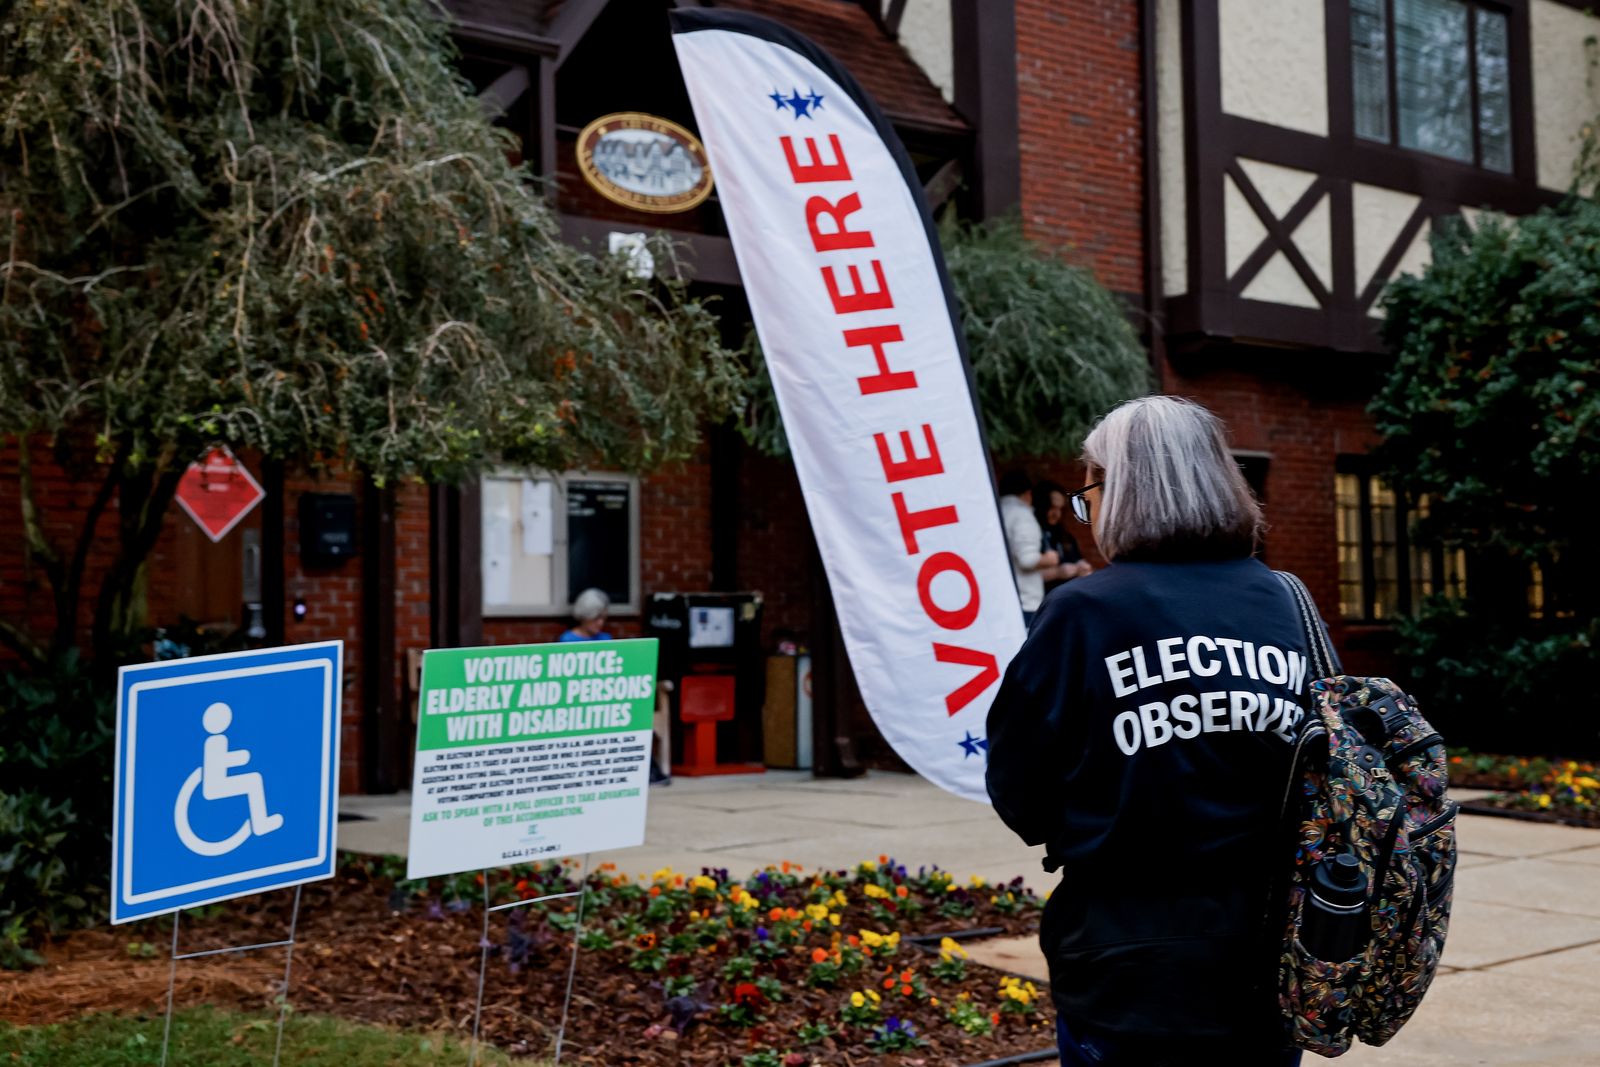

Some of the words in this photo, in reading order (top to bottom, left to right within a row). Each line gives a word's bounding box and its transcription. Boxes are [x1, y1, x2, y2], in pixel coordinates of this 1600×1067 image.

[779, 134, 919, 395] HERE
[873, 424, 1000, 717] VOTE
[464, 654, 543, 683] VOTING
[548, 650, 624, 678] NOTICE:
[1104, 635, 1307, 698] ELECTION
[426, 684, 515, 715] ELDERLY
[517, 681, 562, 708] AND
[566, 675, 653, 704] PERSONS
[446, 713, 503, 742] WITH
[508, 703, 632, 736] DISABILITIES
